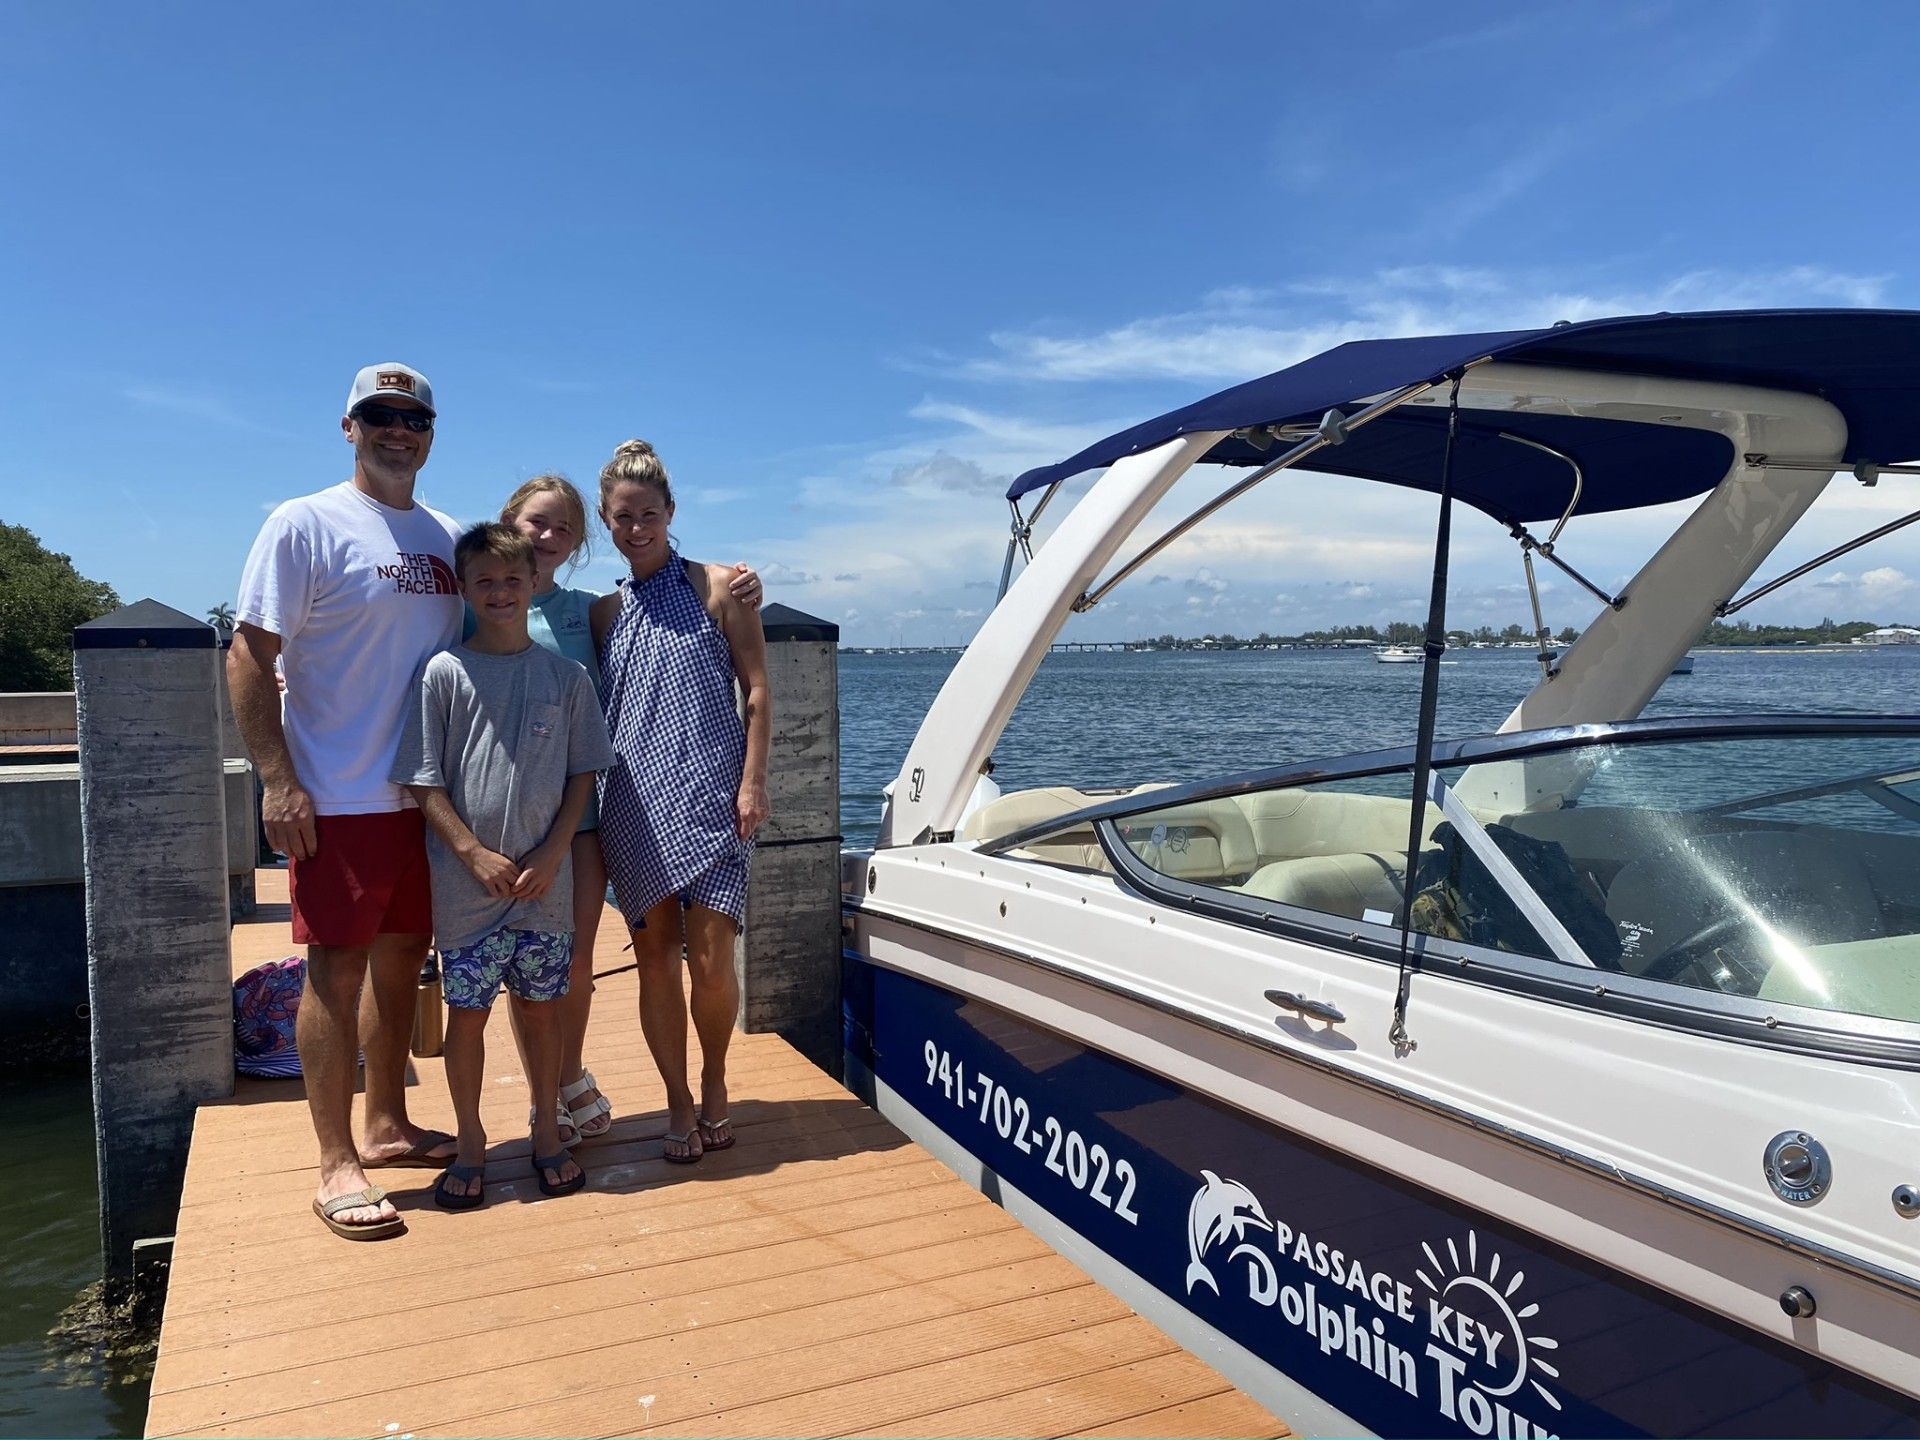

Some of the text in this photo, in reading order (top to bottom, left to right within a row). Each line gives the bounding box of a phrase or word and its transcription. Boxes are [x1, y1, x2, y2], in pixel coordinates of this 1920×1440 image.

[396, 552, 429, 567] THE
[376, 565, 433, 580] NORTH
[396, 579, 435, 595] FACE
[924, 1039, 1139, 1226] 941-702-2022
[1780, 1188, 1812, 1201] WATER
[1276, 1219, 1504, 1369] PASSAGE KEY
[1228, 1243, 1419, 1399] Dolphin
